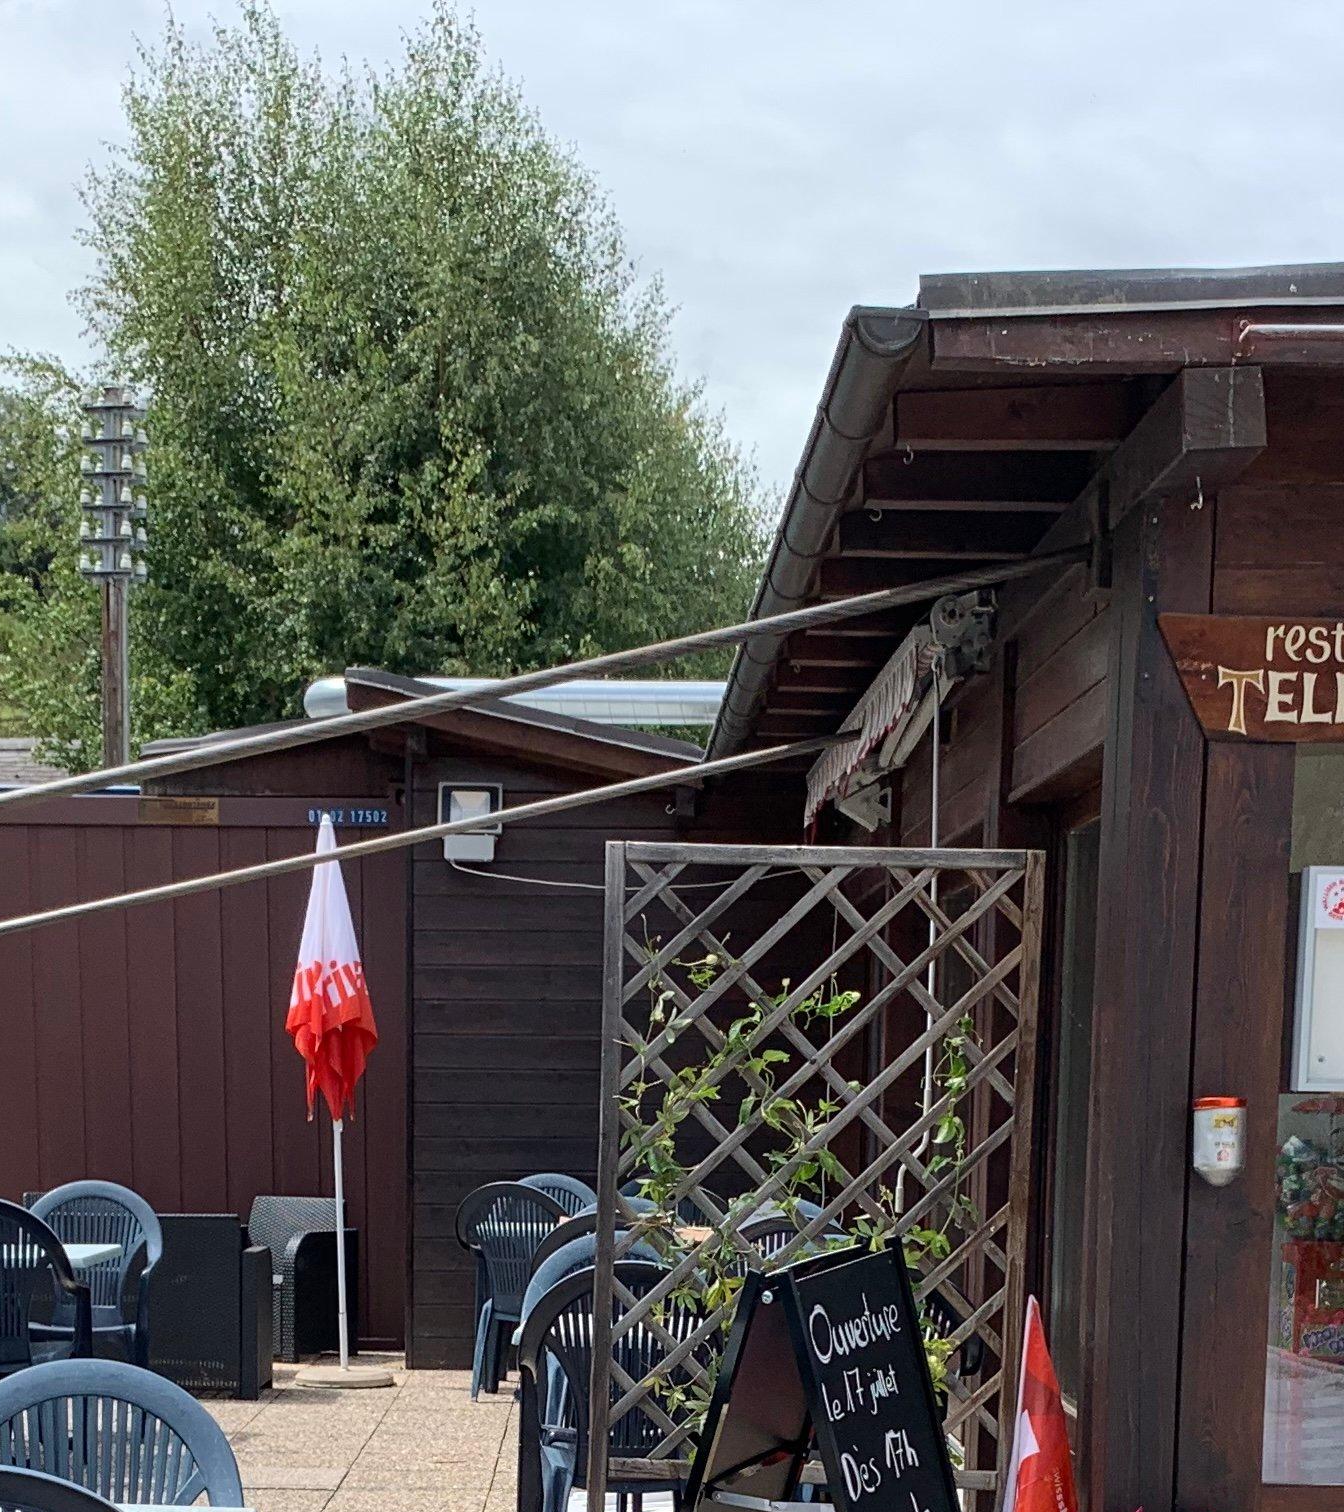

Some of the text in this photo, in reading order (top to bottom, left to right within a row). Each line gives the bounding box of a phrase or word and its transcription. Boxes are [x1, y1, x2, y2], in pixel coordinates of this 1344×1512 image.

[350, 809, 388, 823] 17502
[808, 1292, 902, 1365] Ouverture
[821, 1382, 846, 1422] le
[842, 1366, 865, 1413] 17
[840, 1428, 920, 1503] Dès 17h
